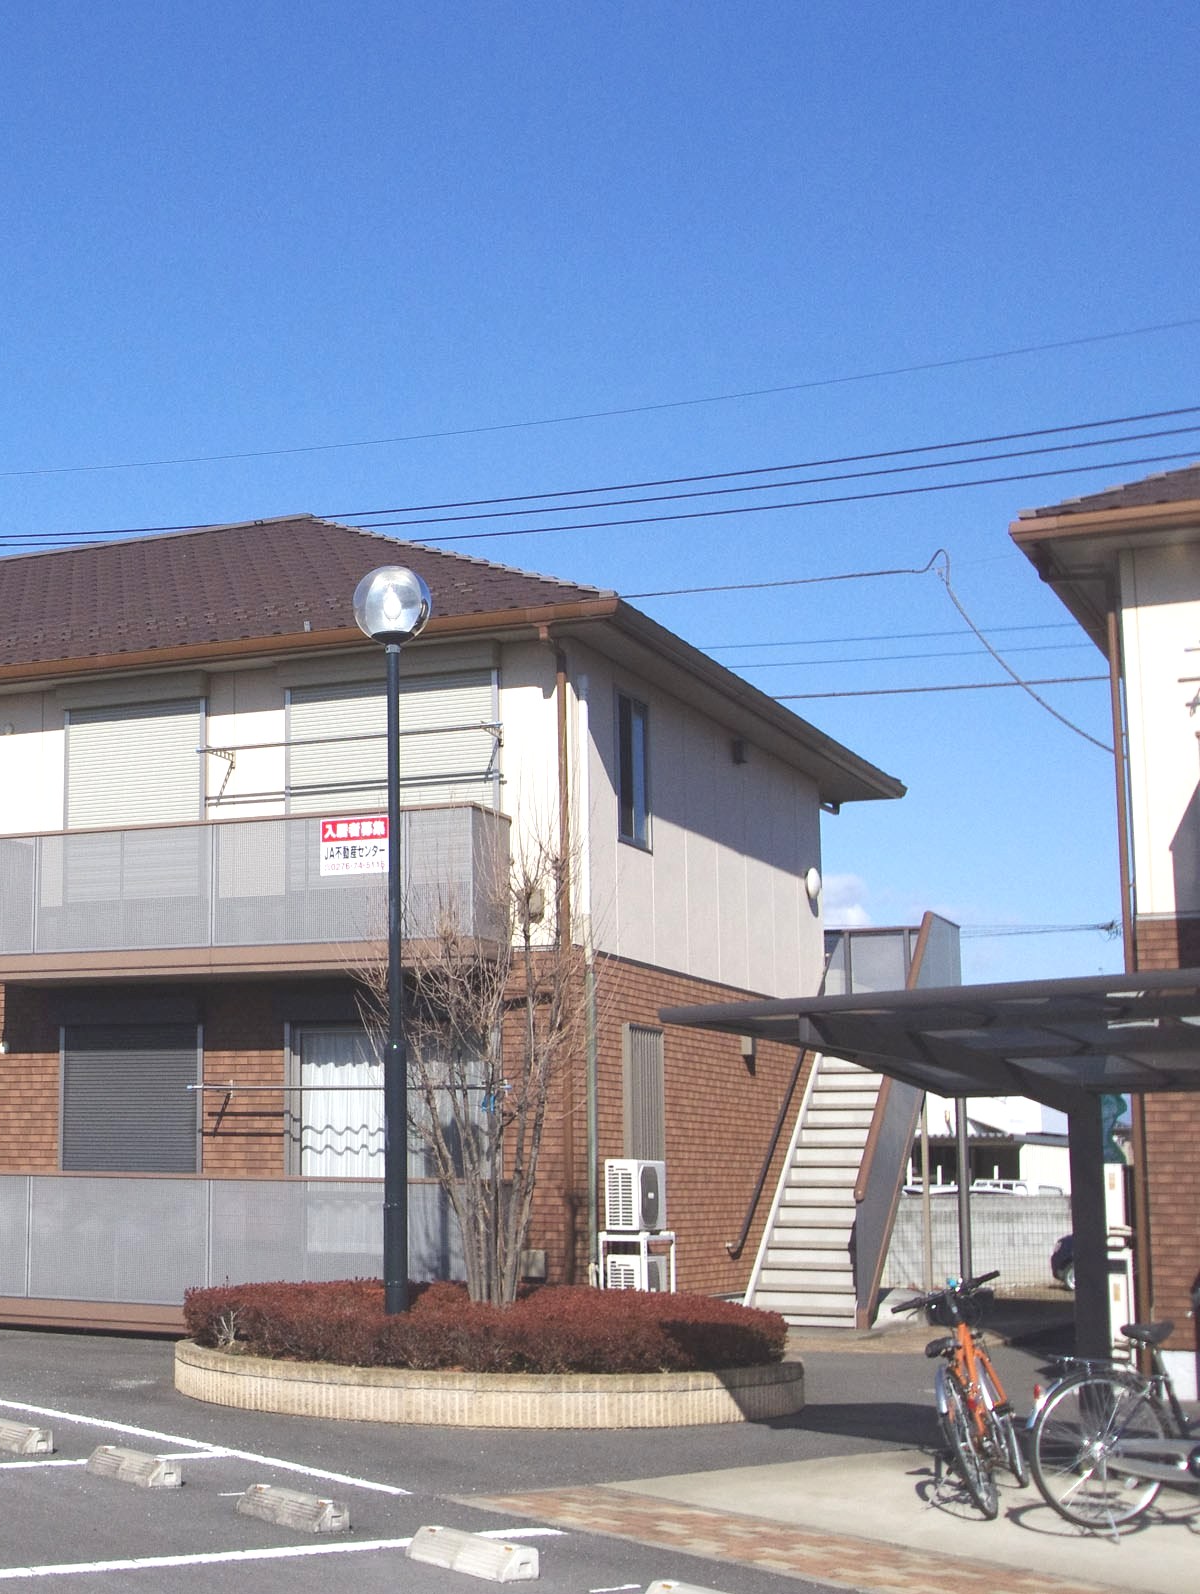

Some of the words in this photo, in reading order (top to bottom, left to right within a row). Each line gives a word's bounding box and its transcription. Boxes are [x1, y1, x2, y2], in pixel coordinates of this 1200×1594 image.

[325, 845, 385, 860] JA不動産センター
